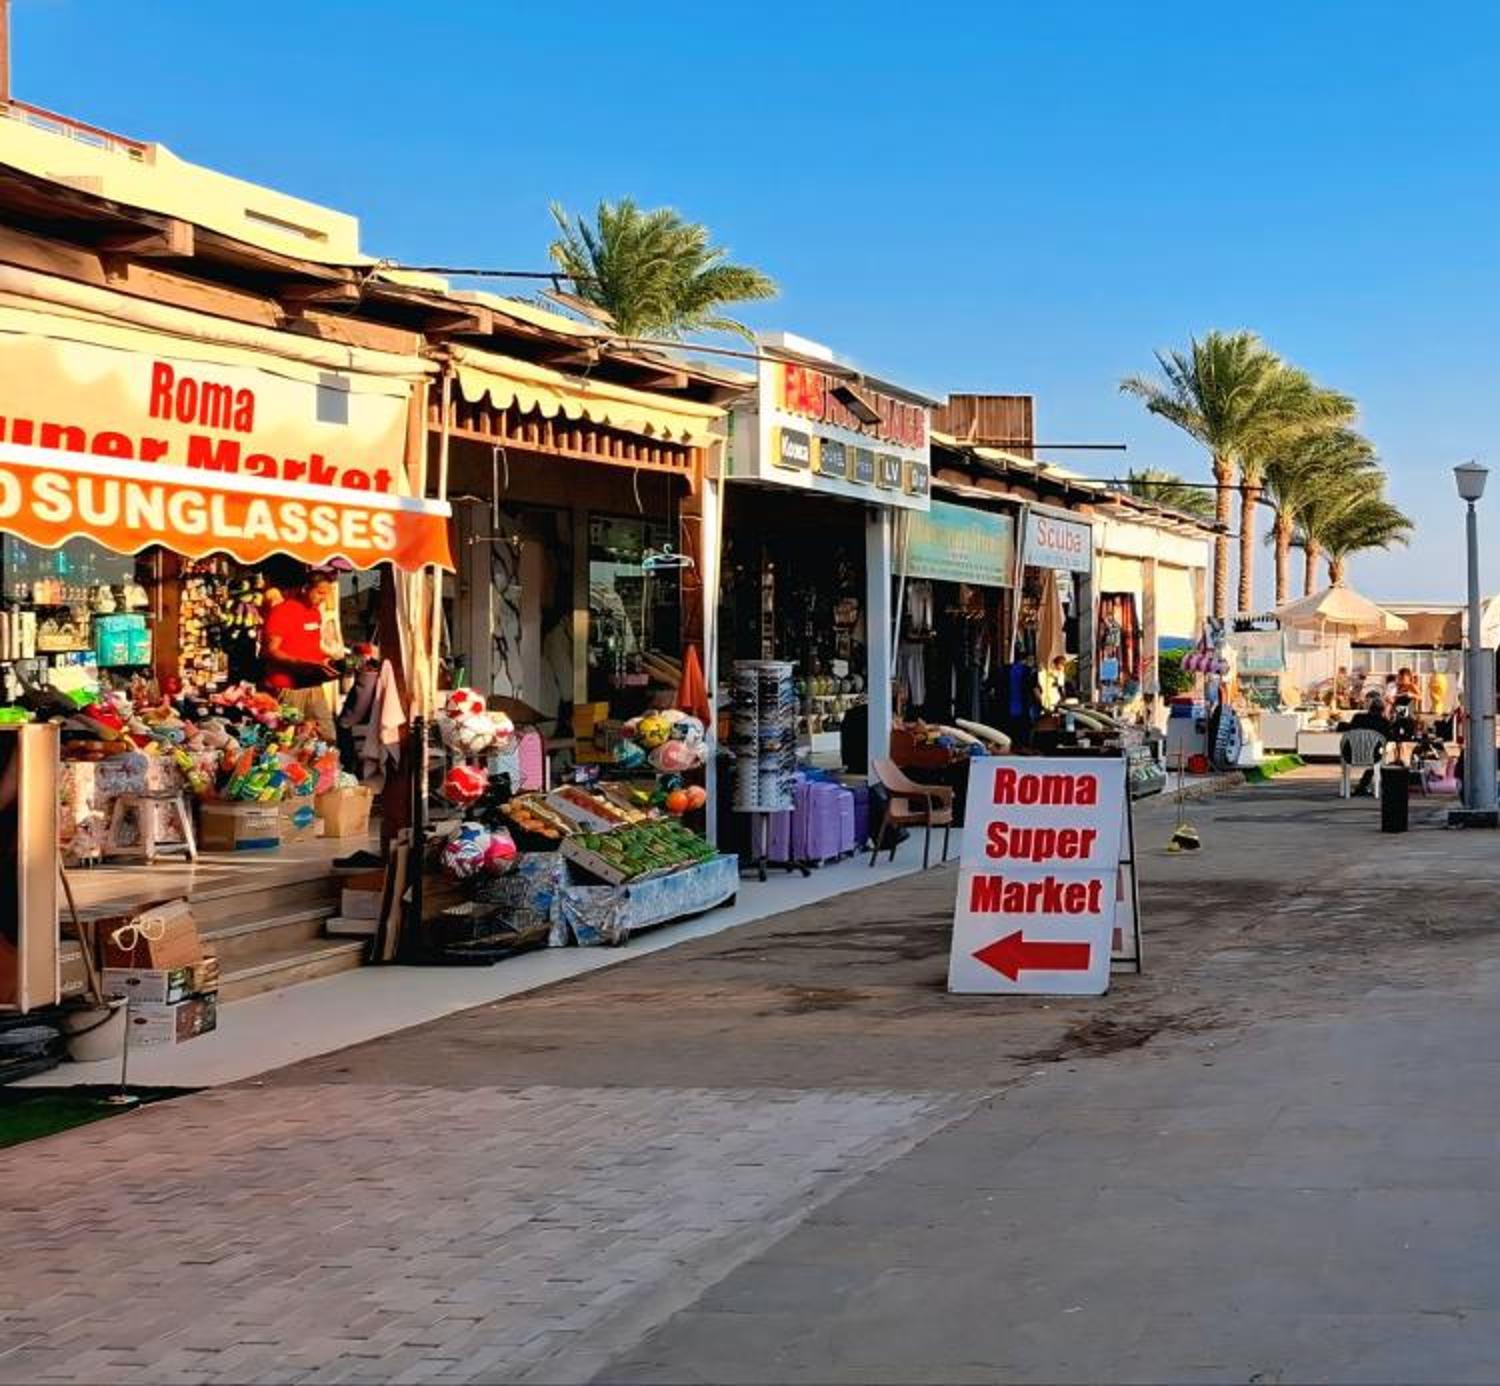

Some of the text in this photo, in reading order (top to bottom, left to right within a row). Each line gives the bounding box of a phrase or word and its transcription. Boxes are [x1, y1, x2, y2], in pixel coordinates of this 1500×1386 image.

[149, 361, 256, 433] Roma
[30, 471, 398, 551] SUNGLASSES
[1037, 519, 1082, 553] Scuba
[992, 767, 1098, 805] Roma
[985, 821, 1097, 863] Super
[970, 875, 1102, 914] Market
